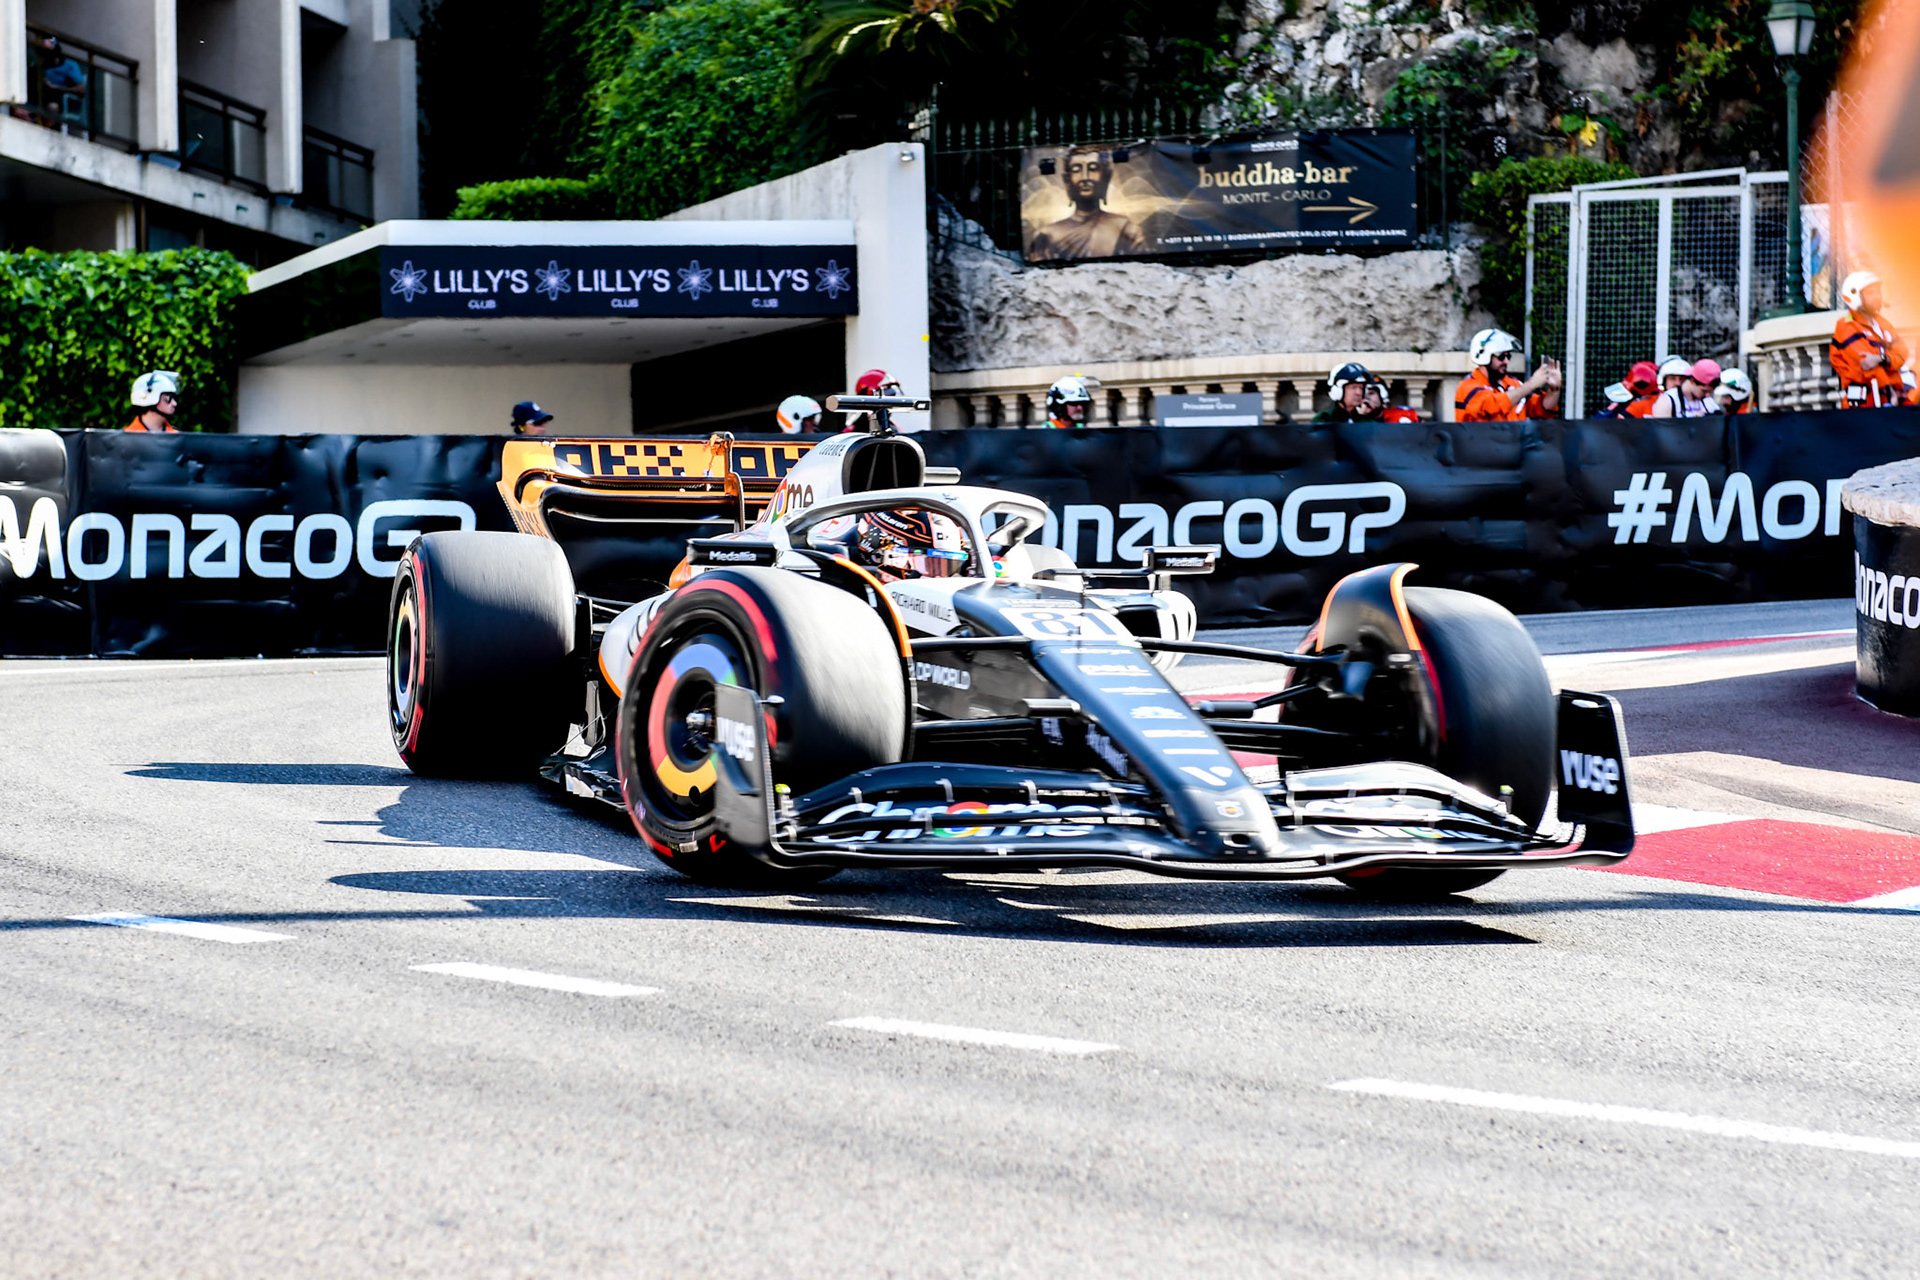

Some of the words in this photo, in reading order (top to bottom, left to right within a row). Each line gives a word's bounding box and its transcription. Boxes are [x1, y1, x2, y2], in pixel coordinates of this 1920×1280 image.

[1198, 161, 1352, 188] buddha-bar
[1222, 191, 1271, 204] MONTE
[1281, 189, 1332, 201] CARLO
[434, 269, 529, 293] LILLY'S
[577, 268, 671, 292] LILLY'S
[719, 268, 810, 292] LILLY'S
[709, 551, 757, 561] Medallia
[1021, 611, 1117, 635] 81
